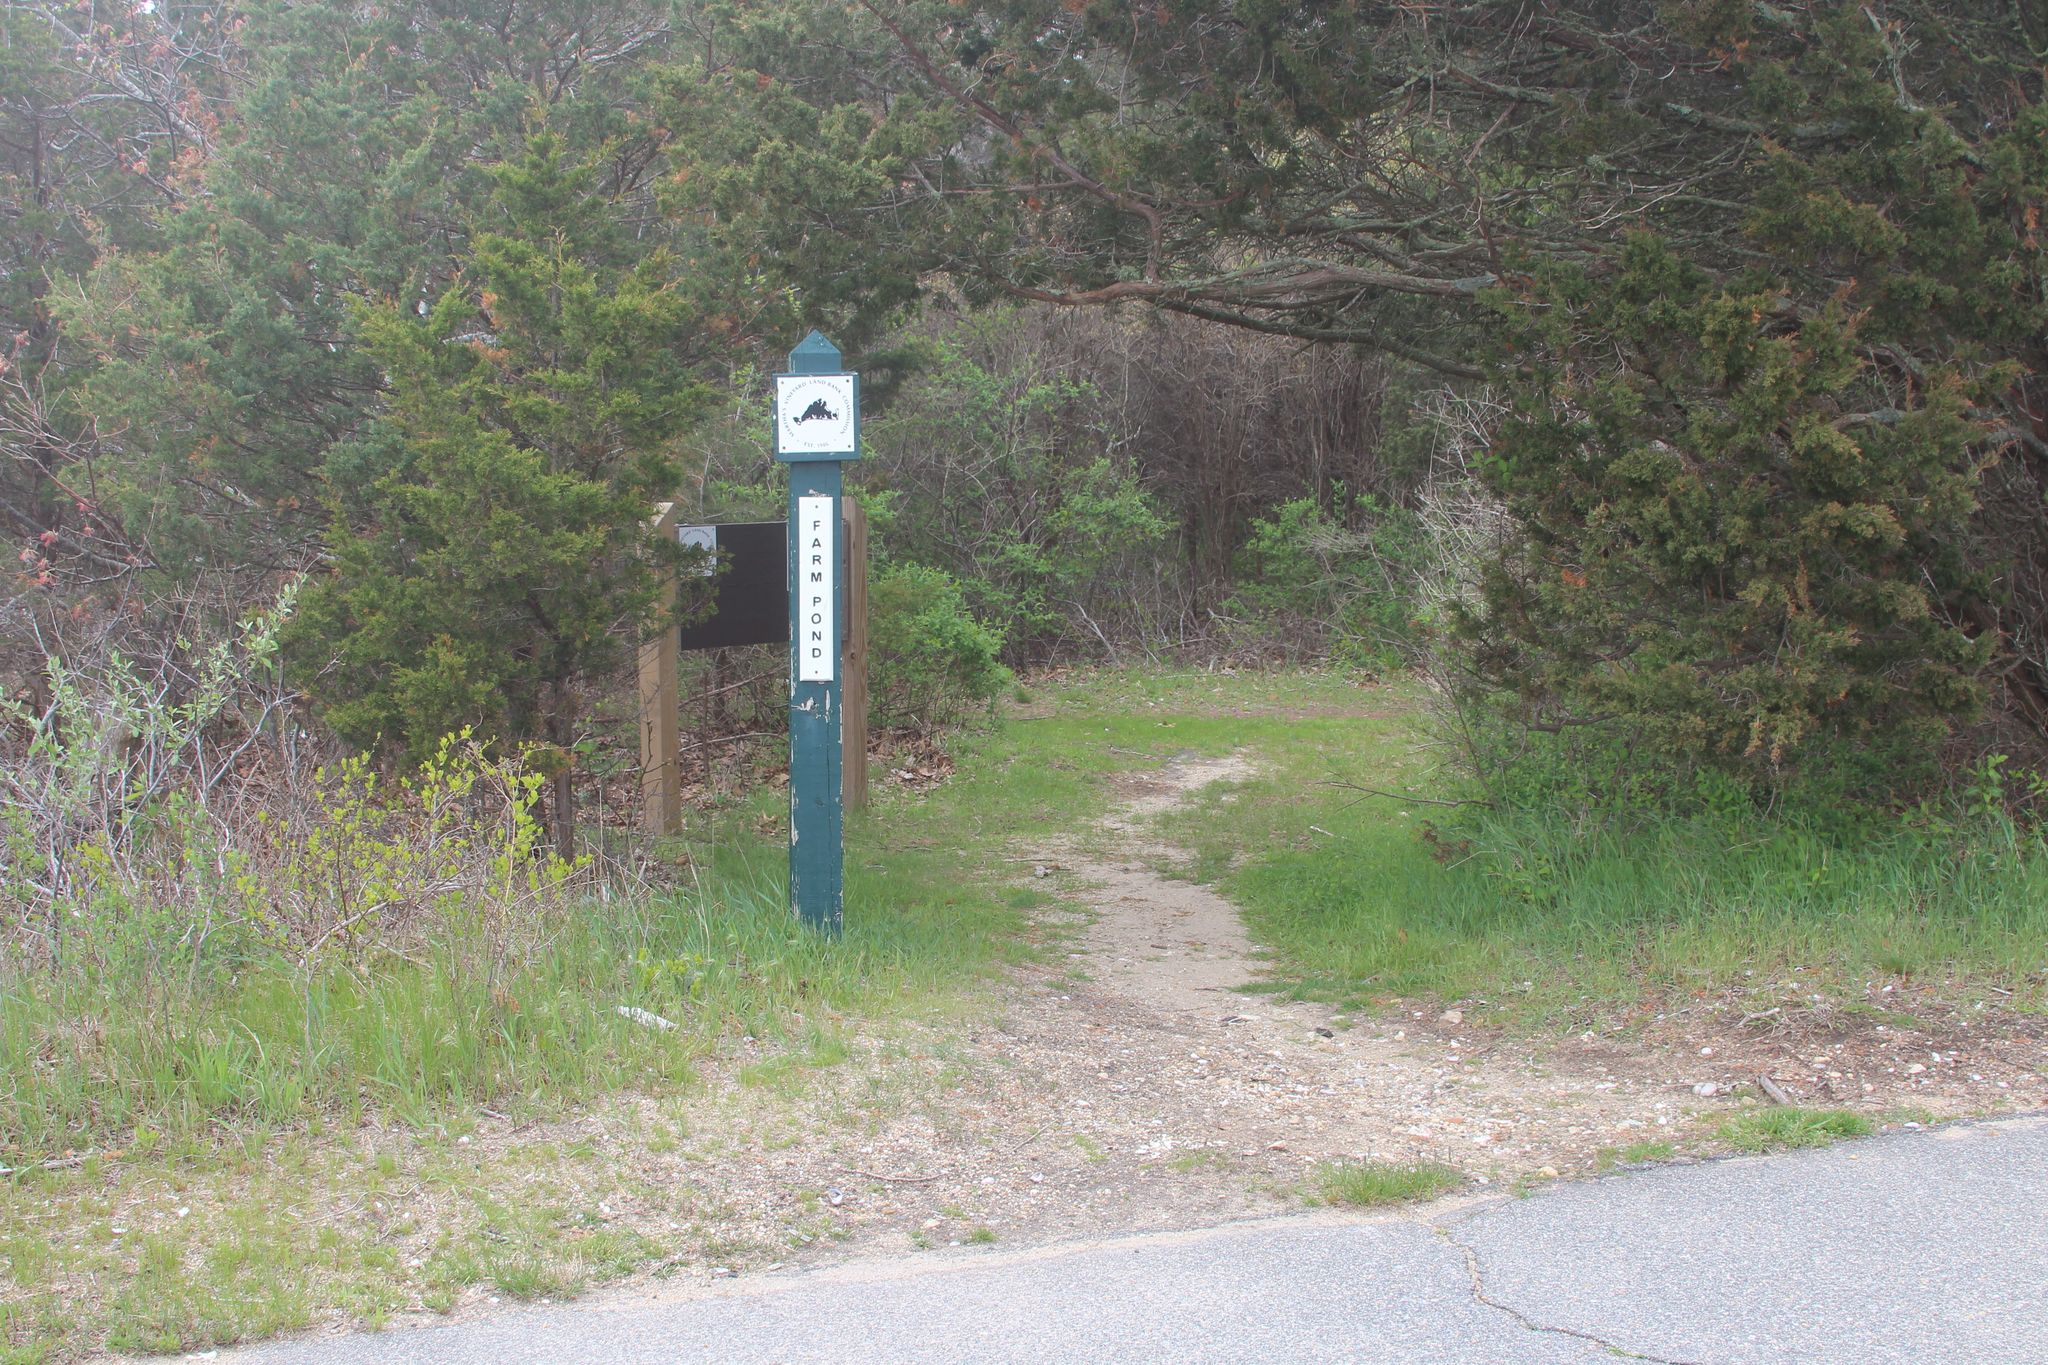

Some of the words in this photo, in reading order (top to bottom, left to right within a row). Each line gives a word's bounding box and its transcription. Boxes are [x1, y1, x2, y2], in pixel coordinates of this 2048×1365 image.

[827, 382, 842, 394] BANK
[811, 520, 822, 583] FARM
[811, 596, 822, 659] POND
